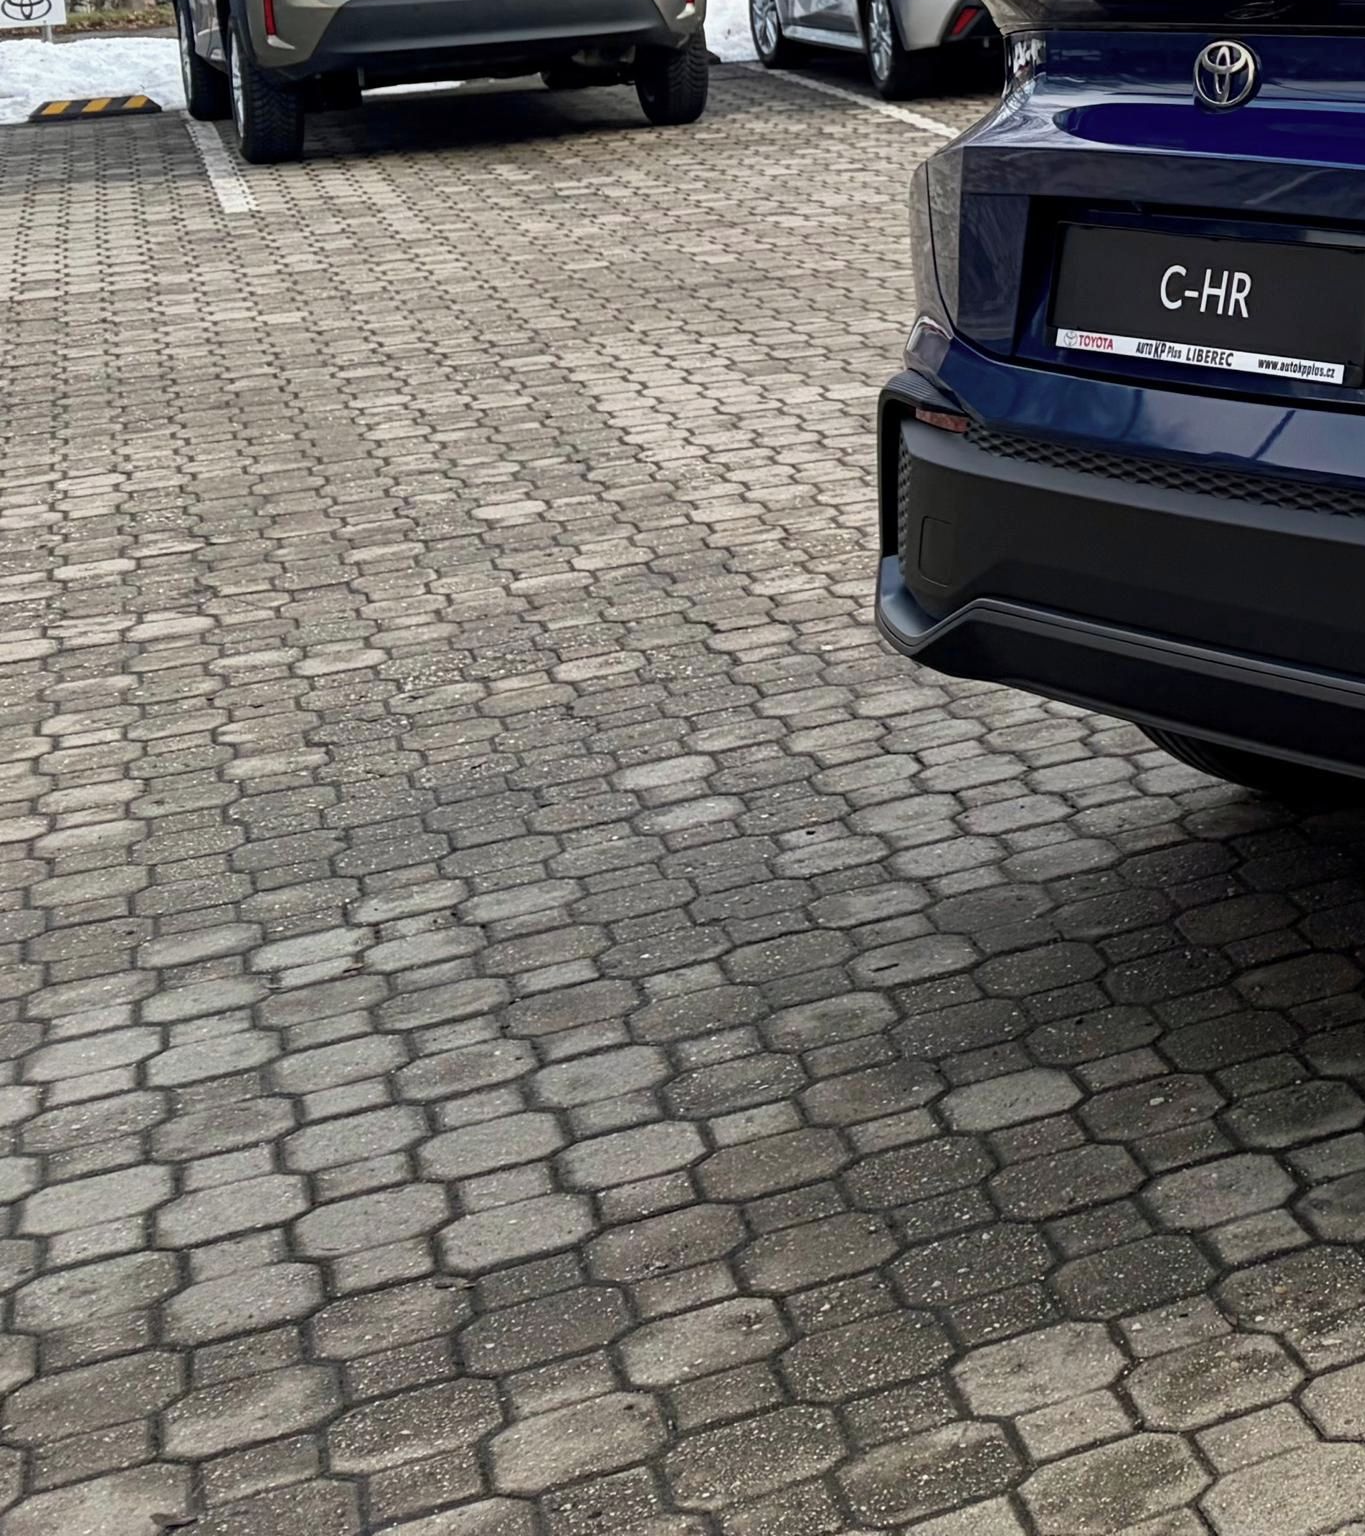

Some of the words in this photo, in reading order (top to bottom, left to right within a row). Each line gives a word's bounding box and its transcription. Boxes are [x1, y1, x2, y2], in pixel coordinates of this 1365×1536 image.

[1160, 264, 1252, 318] C-HR
[1078, 335, 1114, 351] TOYOTA
[1136, 341, 1153, 356] AUTO
[1153, 341, 1167, 359] KP
[1186, 347, 1235, 367] LIBEREC
[1258, 358, 1336, 379] www.autokpplus.cz
